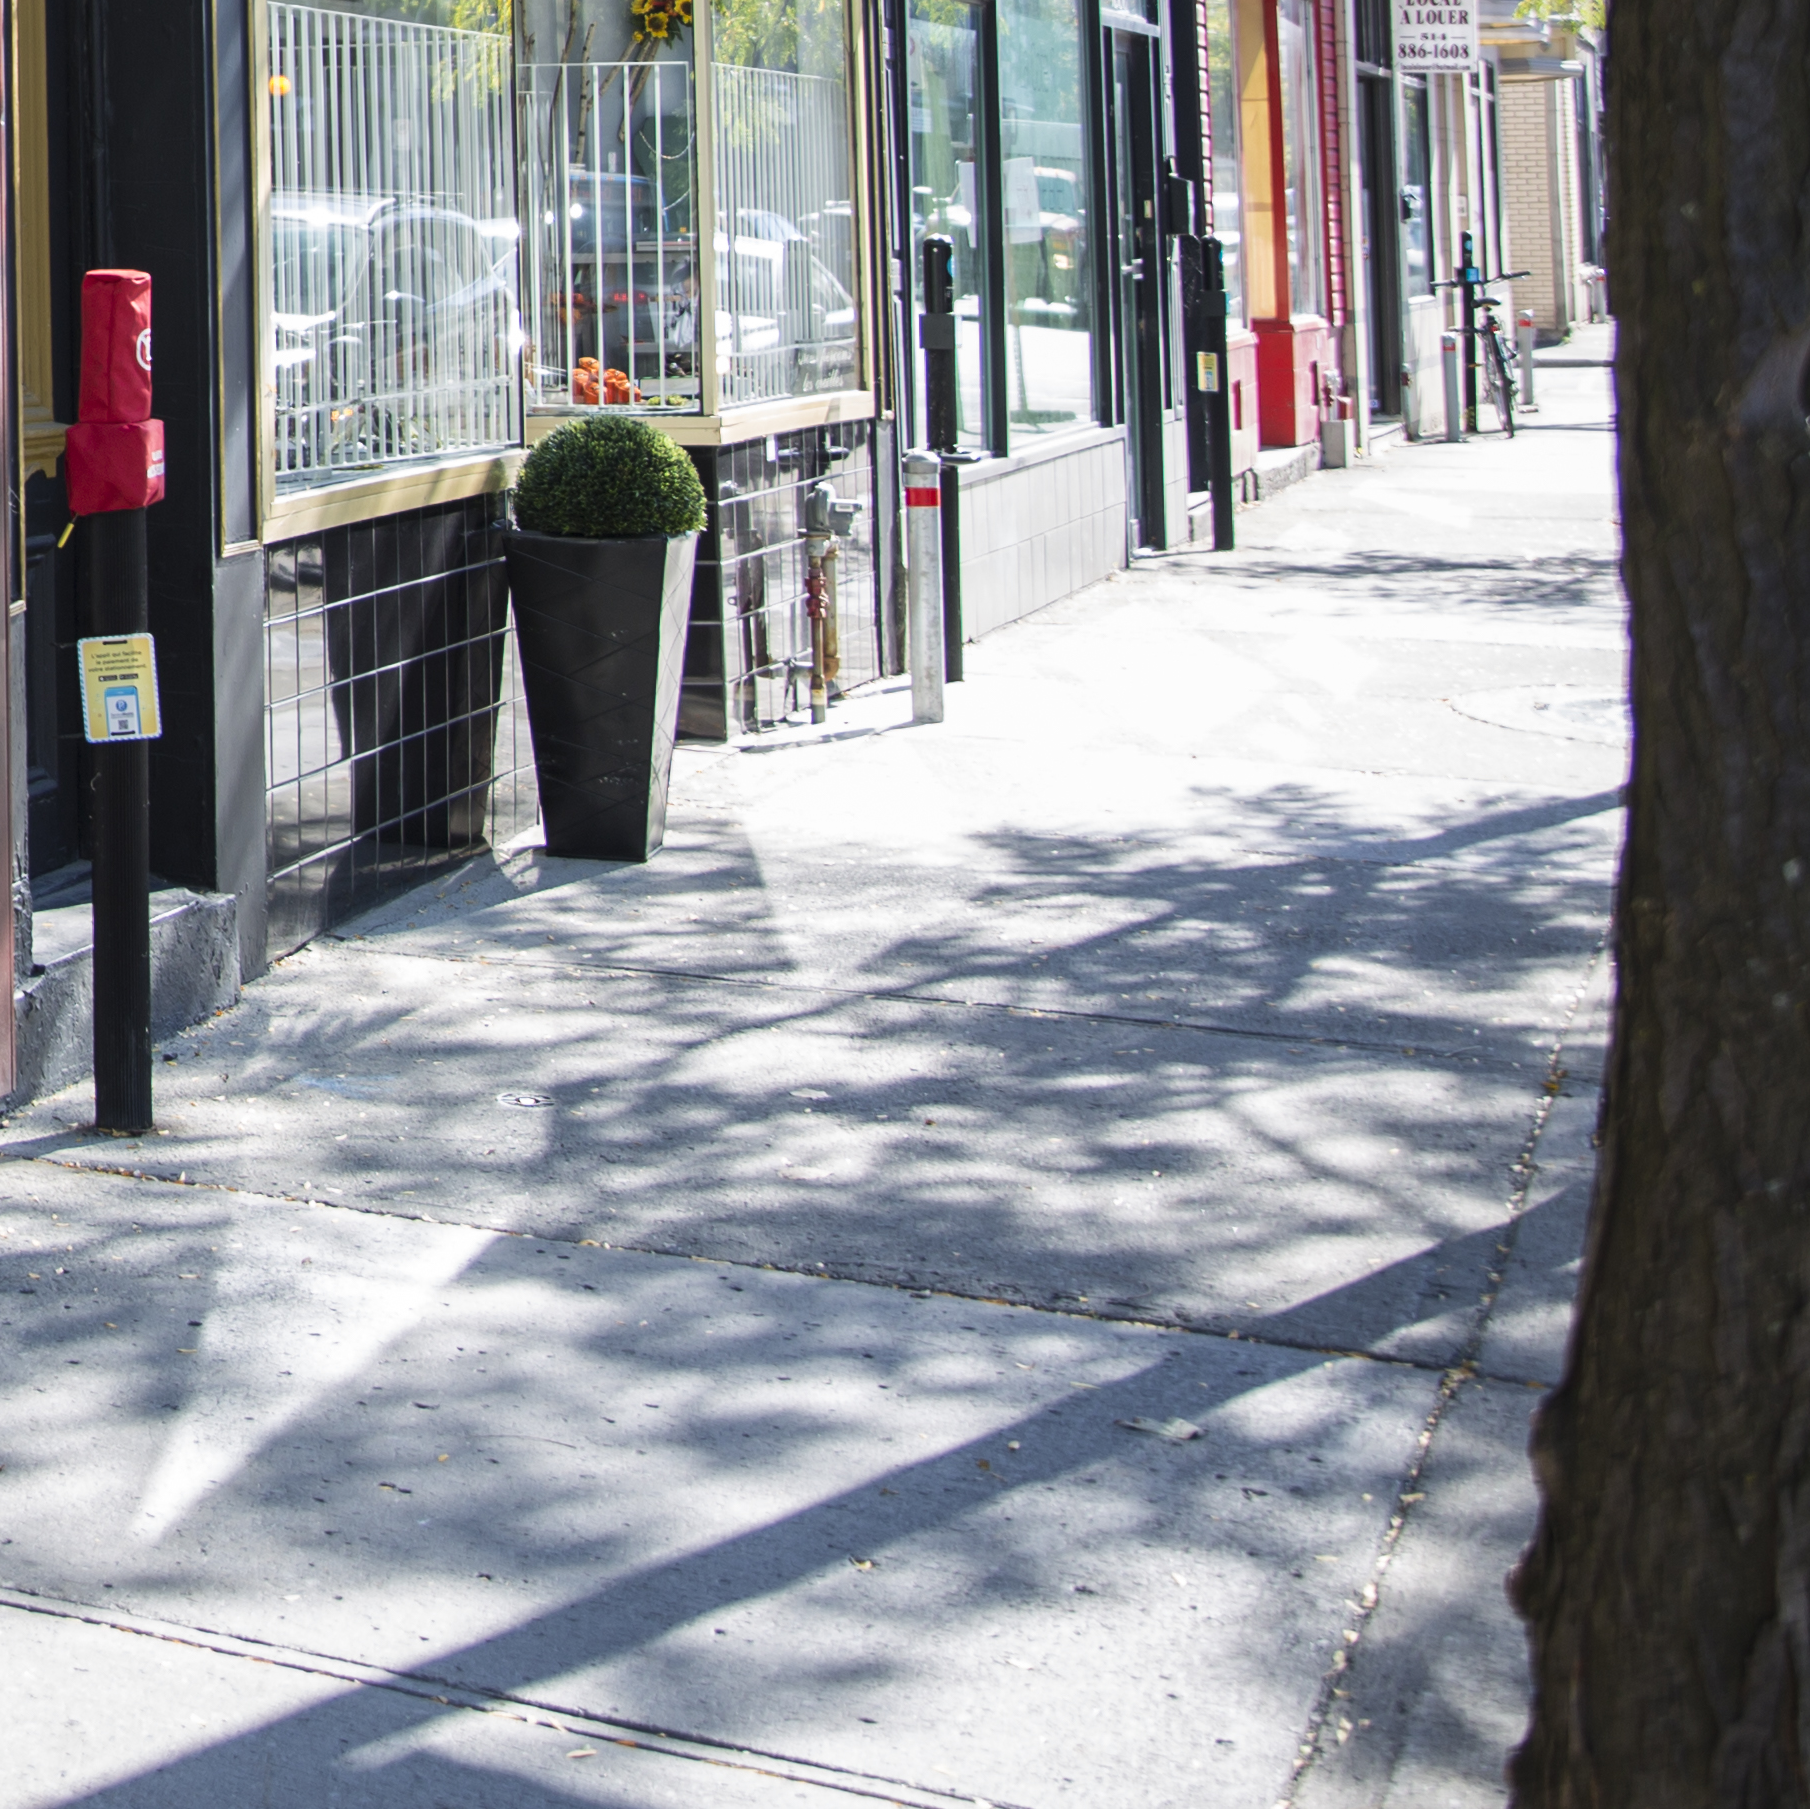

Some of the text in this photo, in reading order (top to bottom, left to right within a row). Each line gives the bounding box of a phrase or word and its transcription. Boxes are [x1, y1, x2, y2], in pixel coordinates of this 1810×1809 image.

[1416, 9, 1469, 25] LOUER
[1420, 32, 1447, 41] 514
[1397, 43, 1470, 59] 886-1608
